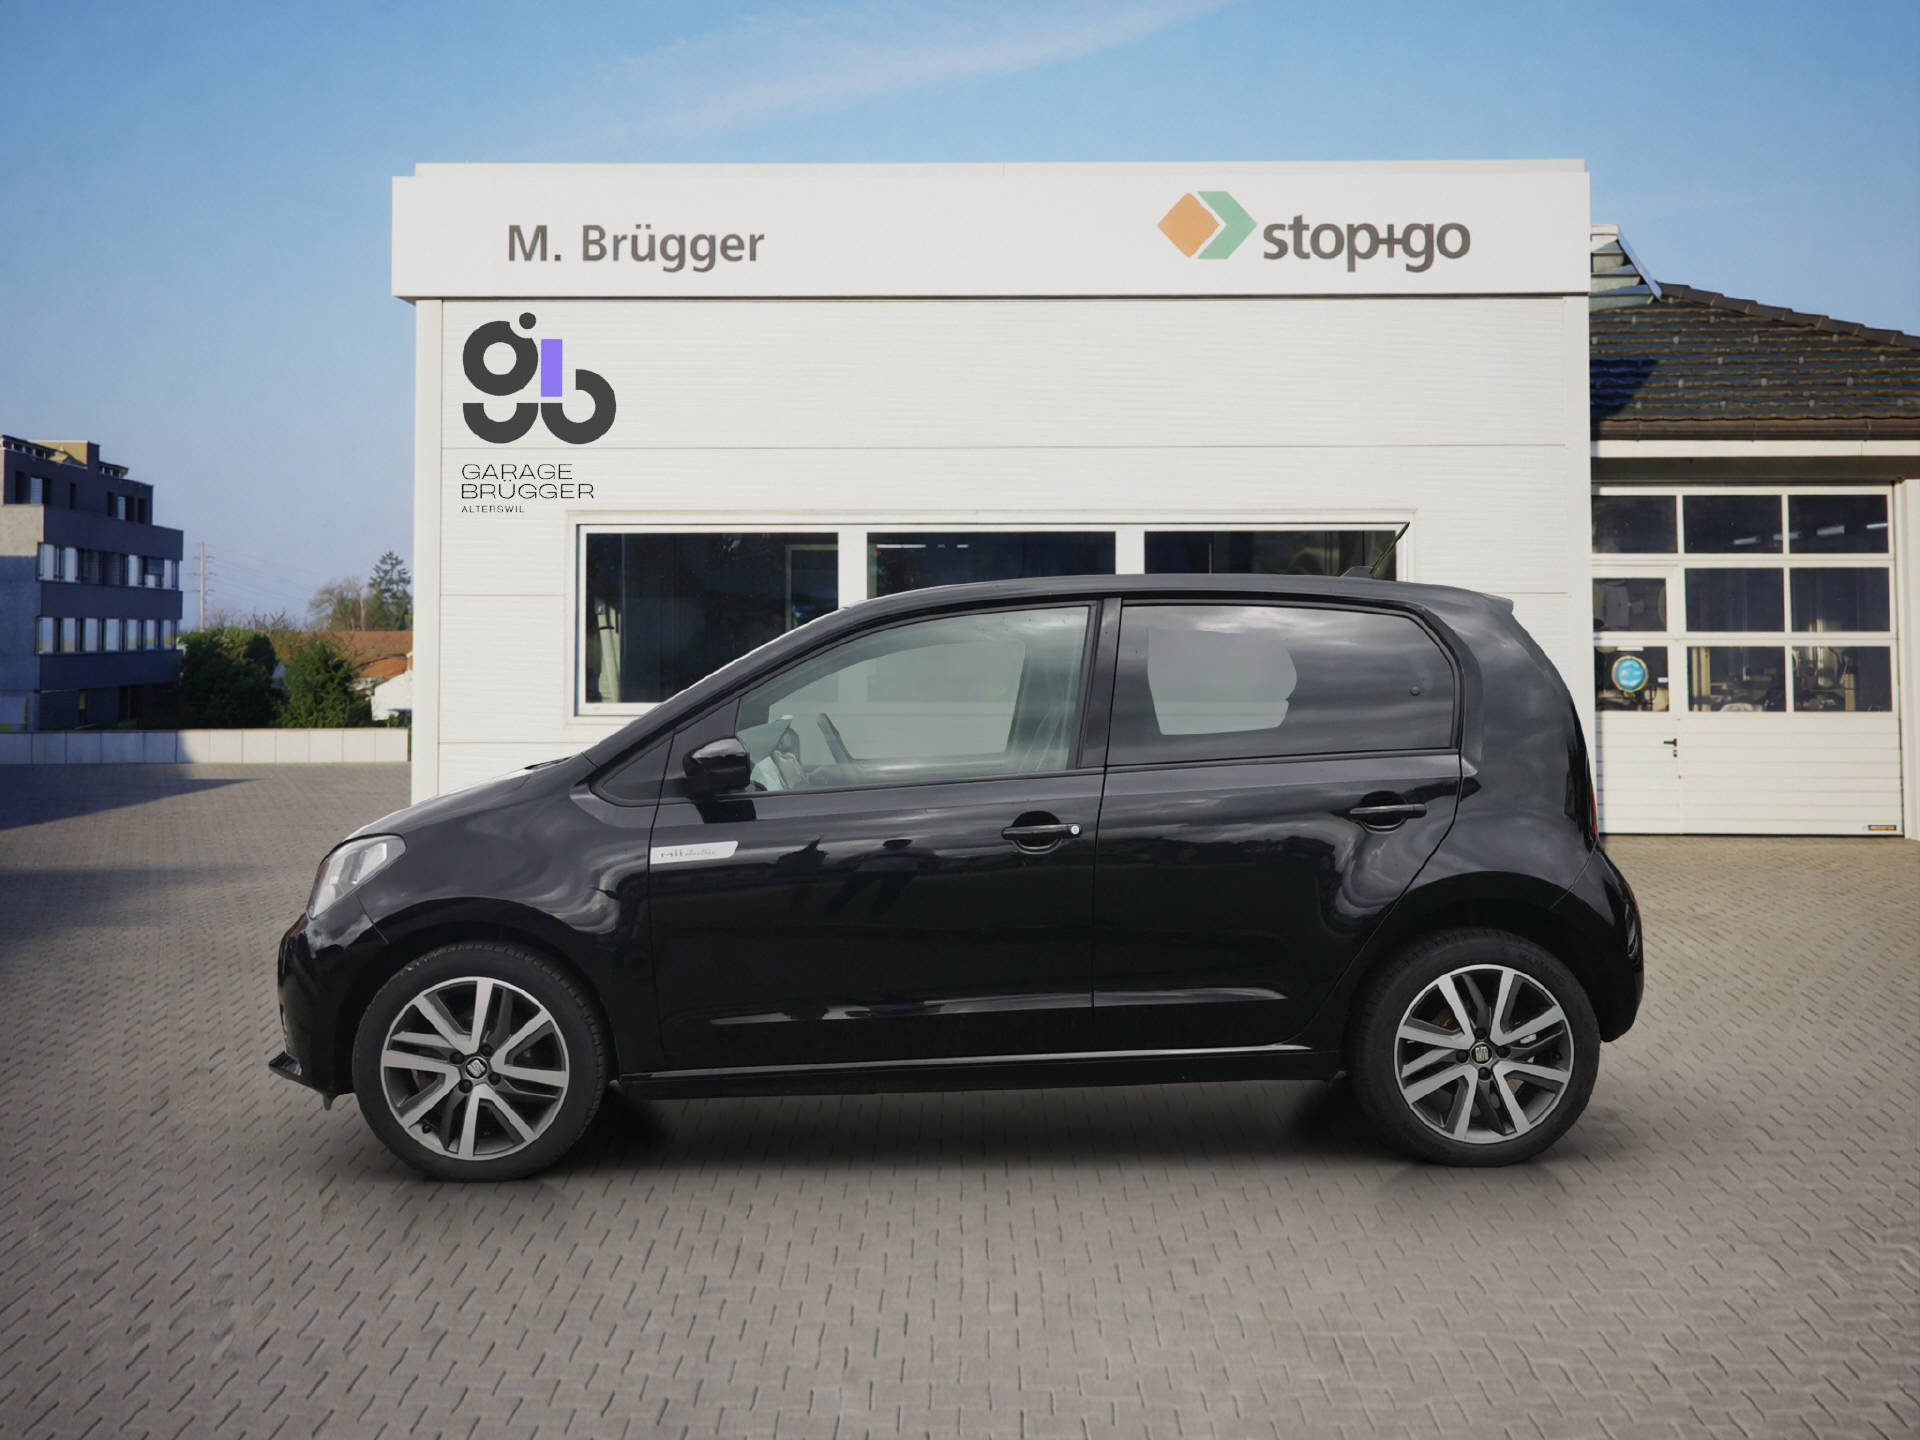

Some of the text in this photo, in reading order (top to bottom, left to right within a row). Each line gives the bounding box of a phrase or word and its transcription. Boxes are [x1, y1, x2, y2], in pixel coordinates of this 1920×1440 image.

[508, 223, 765, 273] M. Brügger
[1263, 214, 1471, 273] stop+go
[461, 463, 573, 480] GARAGE
[461, 479, 594, 499] BRÜGGER
[461, 505, 525, 513] ALTERSWIL
